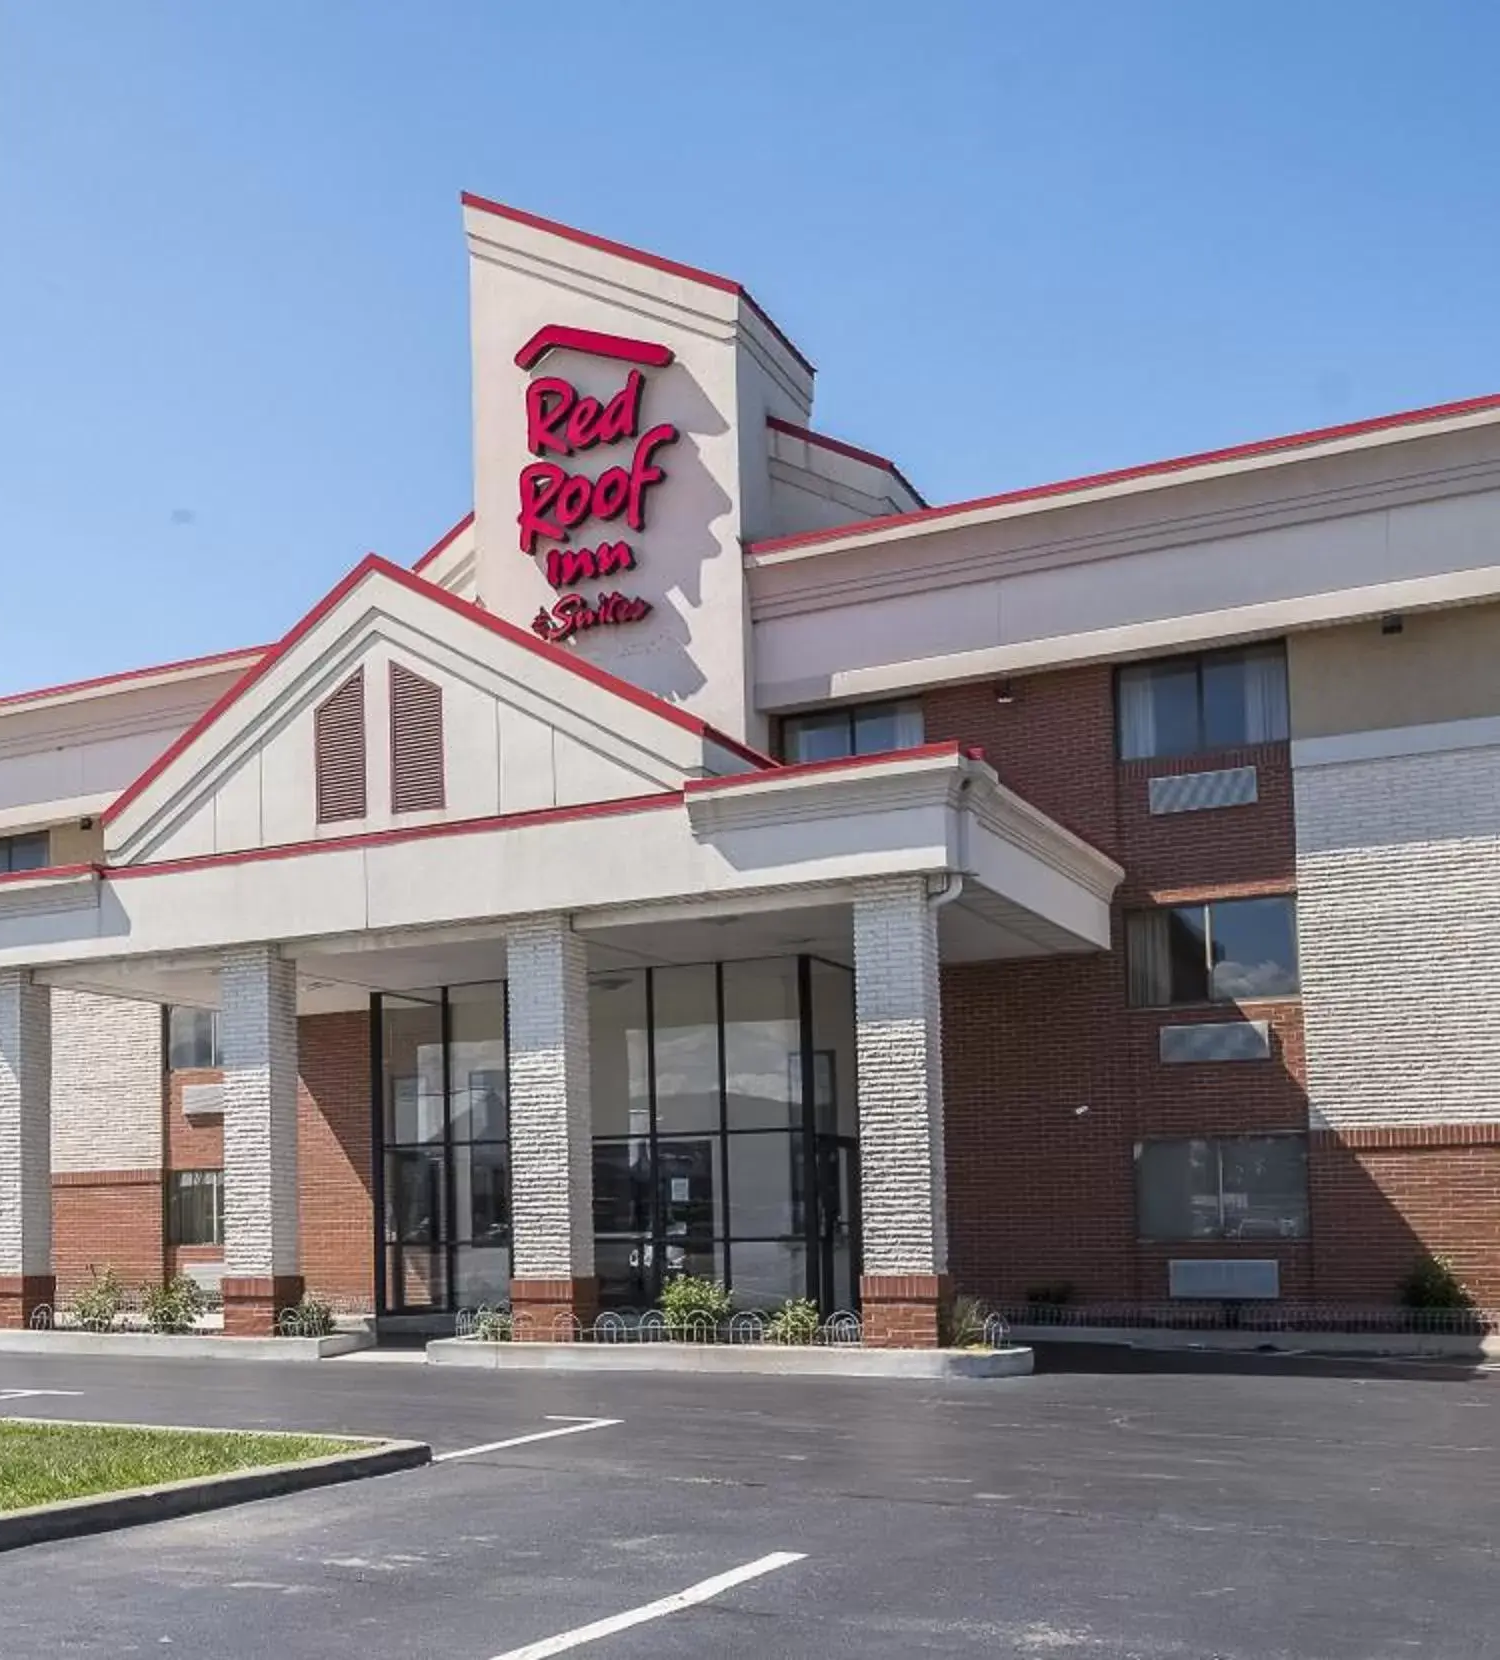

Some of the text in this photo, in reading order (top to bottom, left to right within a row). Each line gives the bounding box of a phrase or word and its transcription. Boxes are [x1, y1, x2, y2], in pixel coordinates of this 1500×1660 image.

[526, 368, 645, 457] Red
[518, 424, 680, 555] Roof
[547, 541, 637, 588] Inn
[548, 592, 654, 642] Suites
